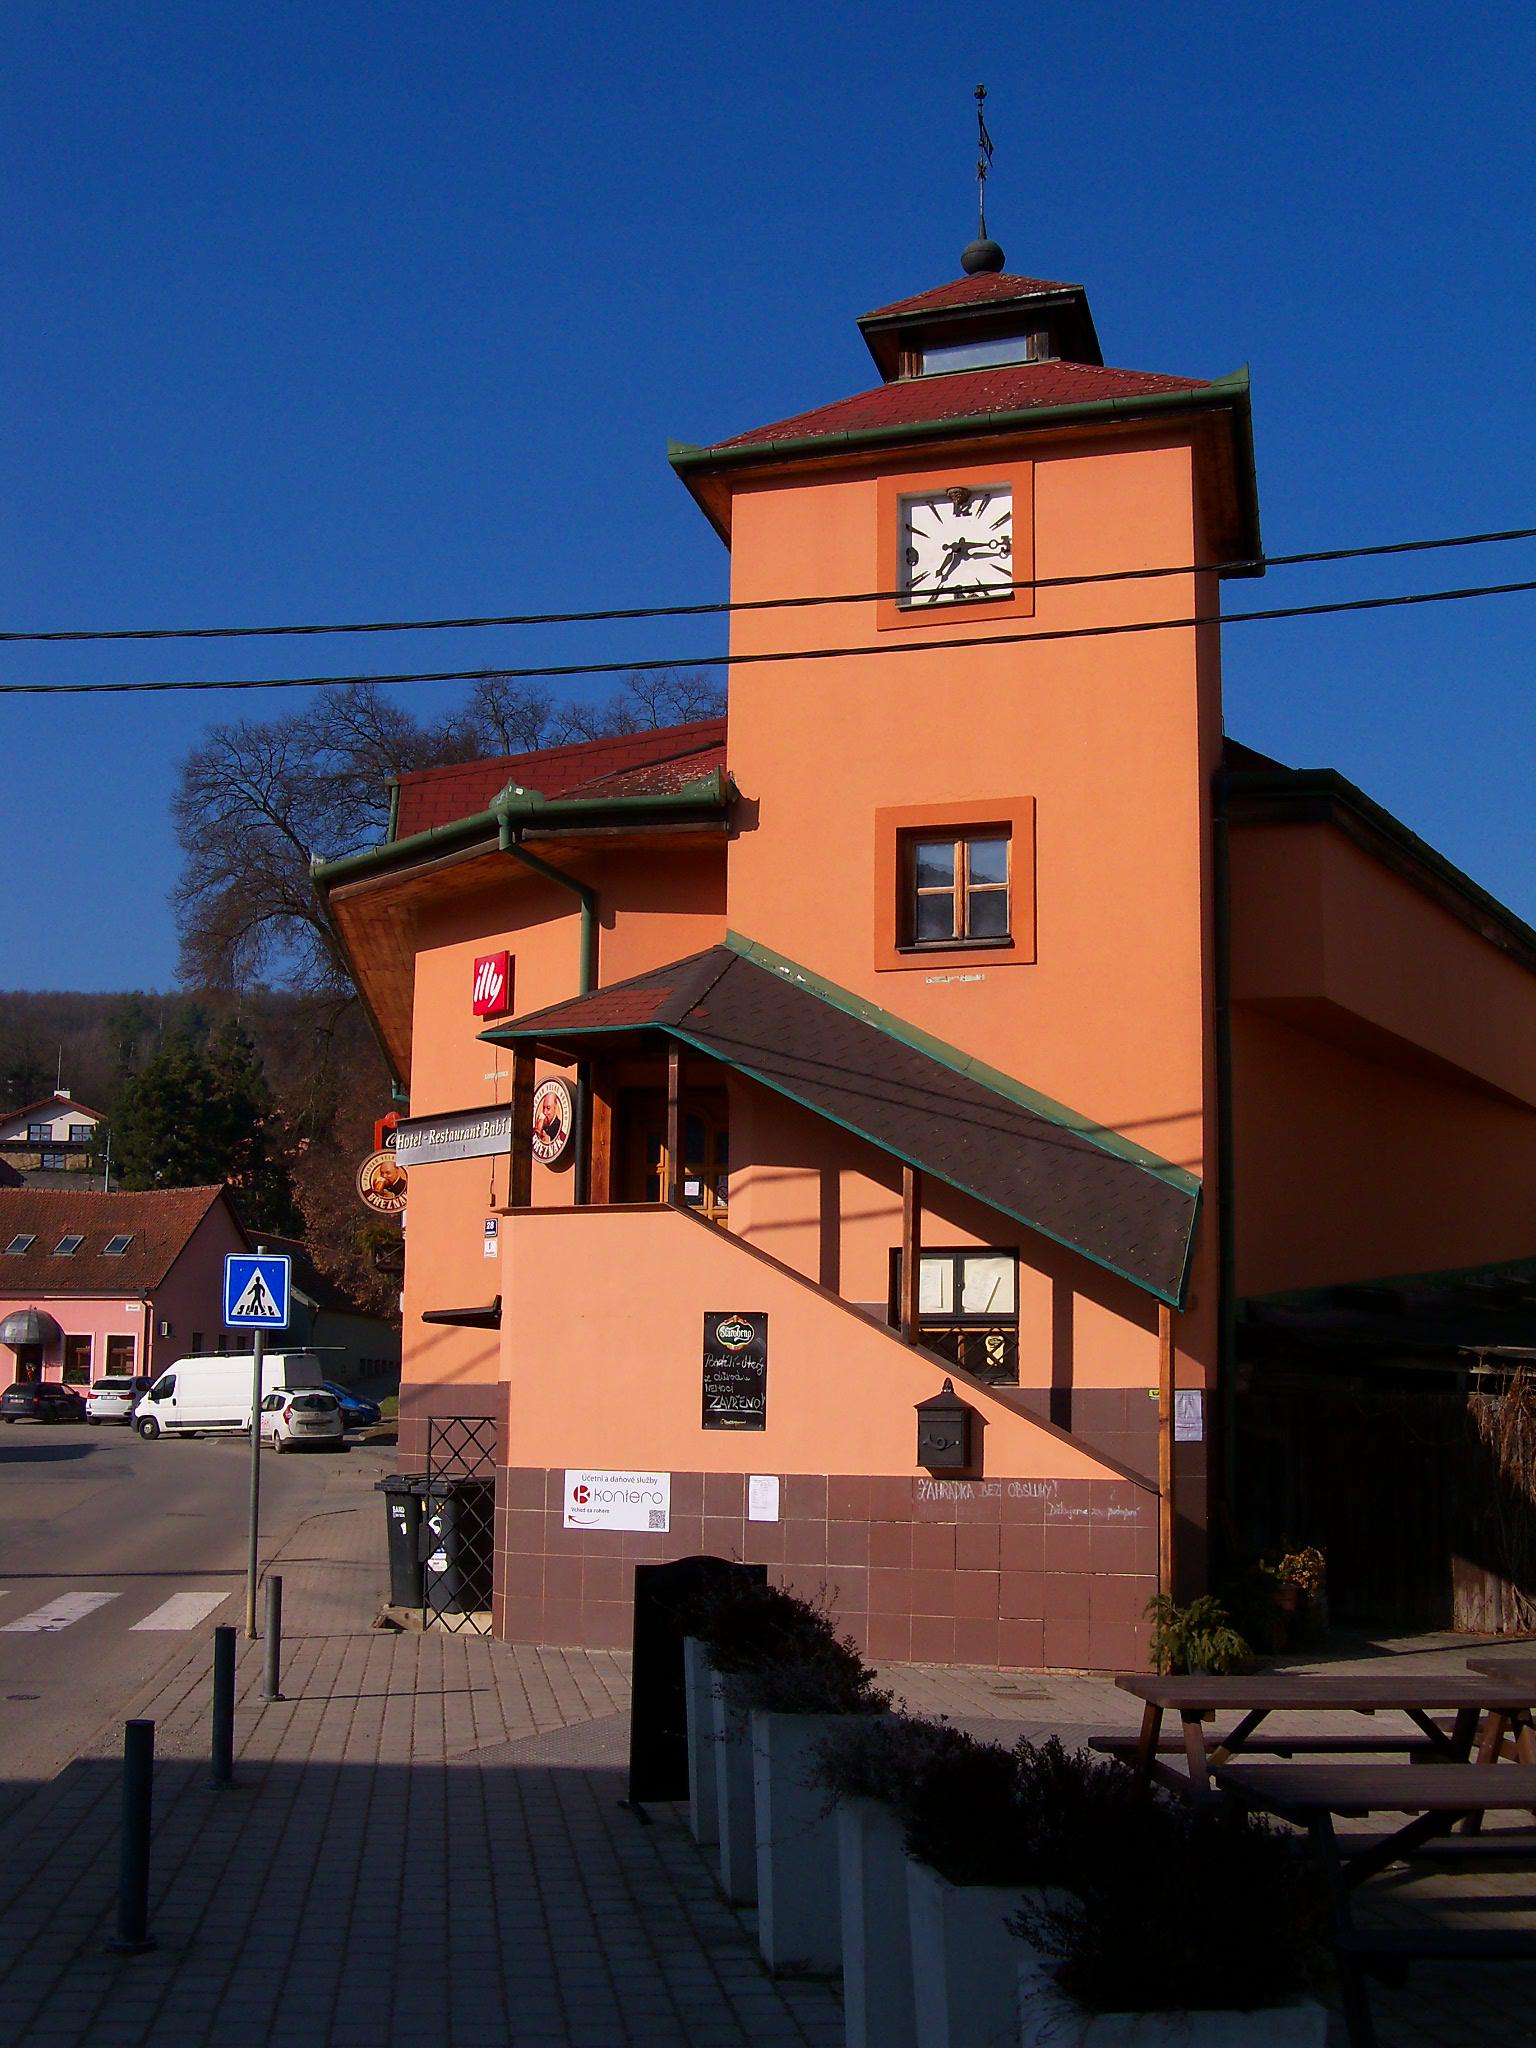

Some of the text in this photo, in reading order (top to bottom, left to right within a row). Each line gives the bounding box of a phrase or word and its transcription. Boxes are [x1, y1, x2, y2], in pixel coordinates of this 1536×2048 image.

[473, 961, 504, 1009] illy
[397, 1130, 423, 1150] Hotel
[428, 1125, 482, 1145] Restaurant
[483, 1117, 508, 1138] Babí
[486, 1220, 495, 1230] 28
[594, 1488, 664, 1505] kontero
